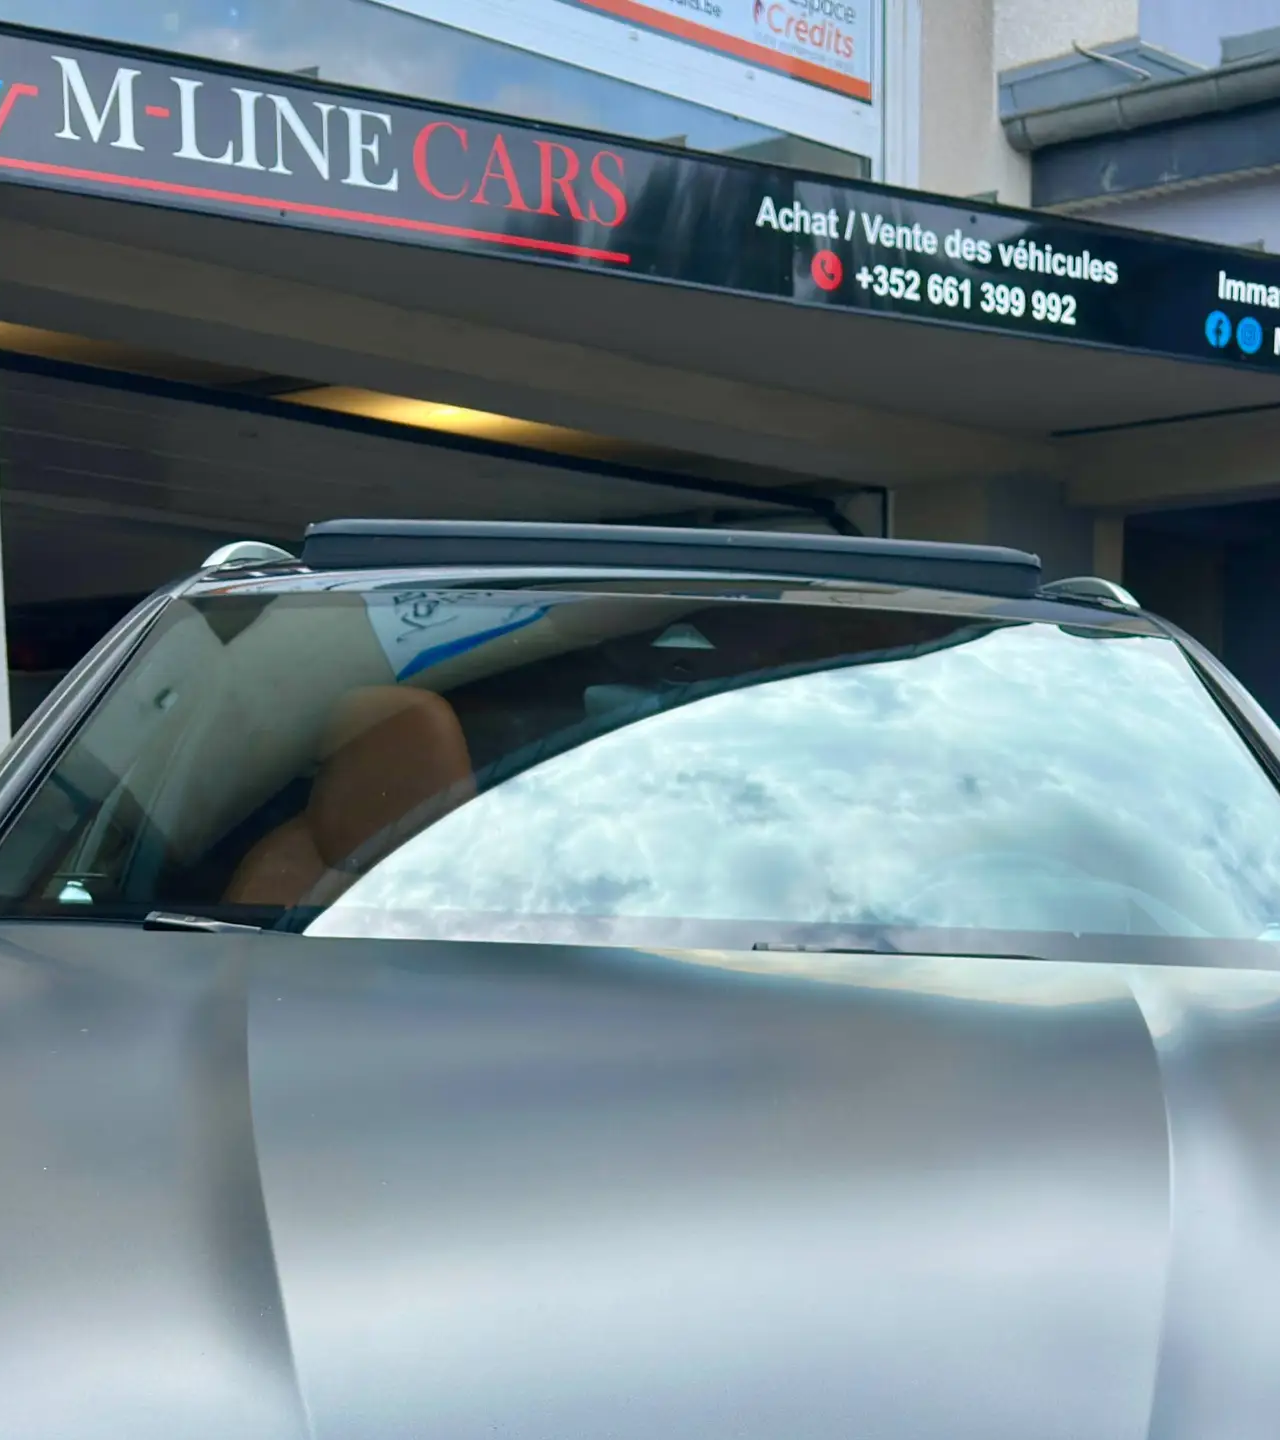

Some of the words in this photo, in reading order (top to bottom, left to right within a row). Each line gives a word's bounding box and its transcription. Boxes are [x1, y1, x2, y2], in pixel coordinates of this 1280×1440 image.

[767, 3, 854, 58] Crédits
[50, 55, 398, 192] M-LINE
[412, 121, 629, 227] CARS
[755, 196, 839, 239] Achat
[844, 209, 855, 241] /
[861, 212, 937, 254] Vente
[944, 229, 992, 264] des
[998, 239, 1119, 285] véhicules
[855, 265, 921, 301] +352
[927, 273, 971, 309] 661
[980, 282, 1026, 318] 399
[1031, 290, 1076, 326] 992
